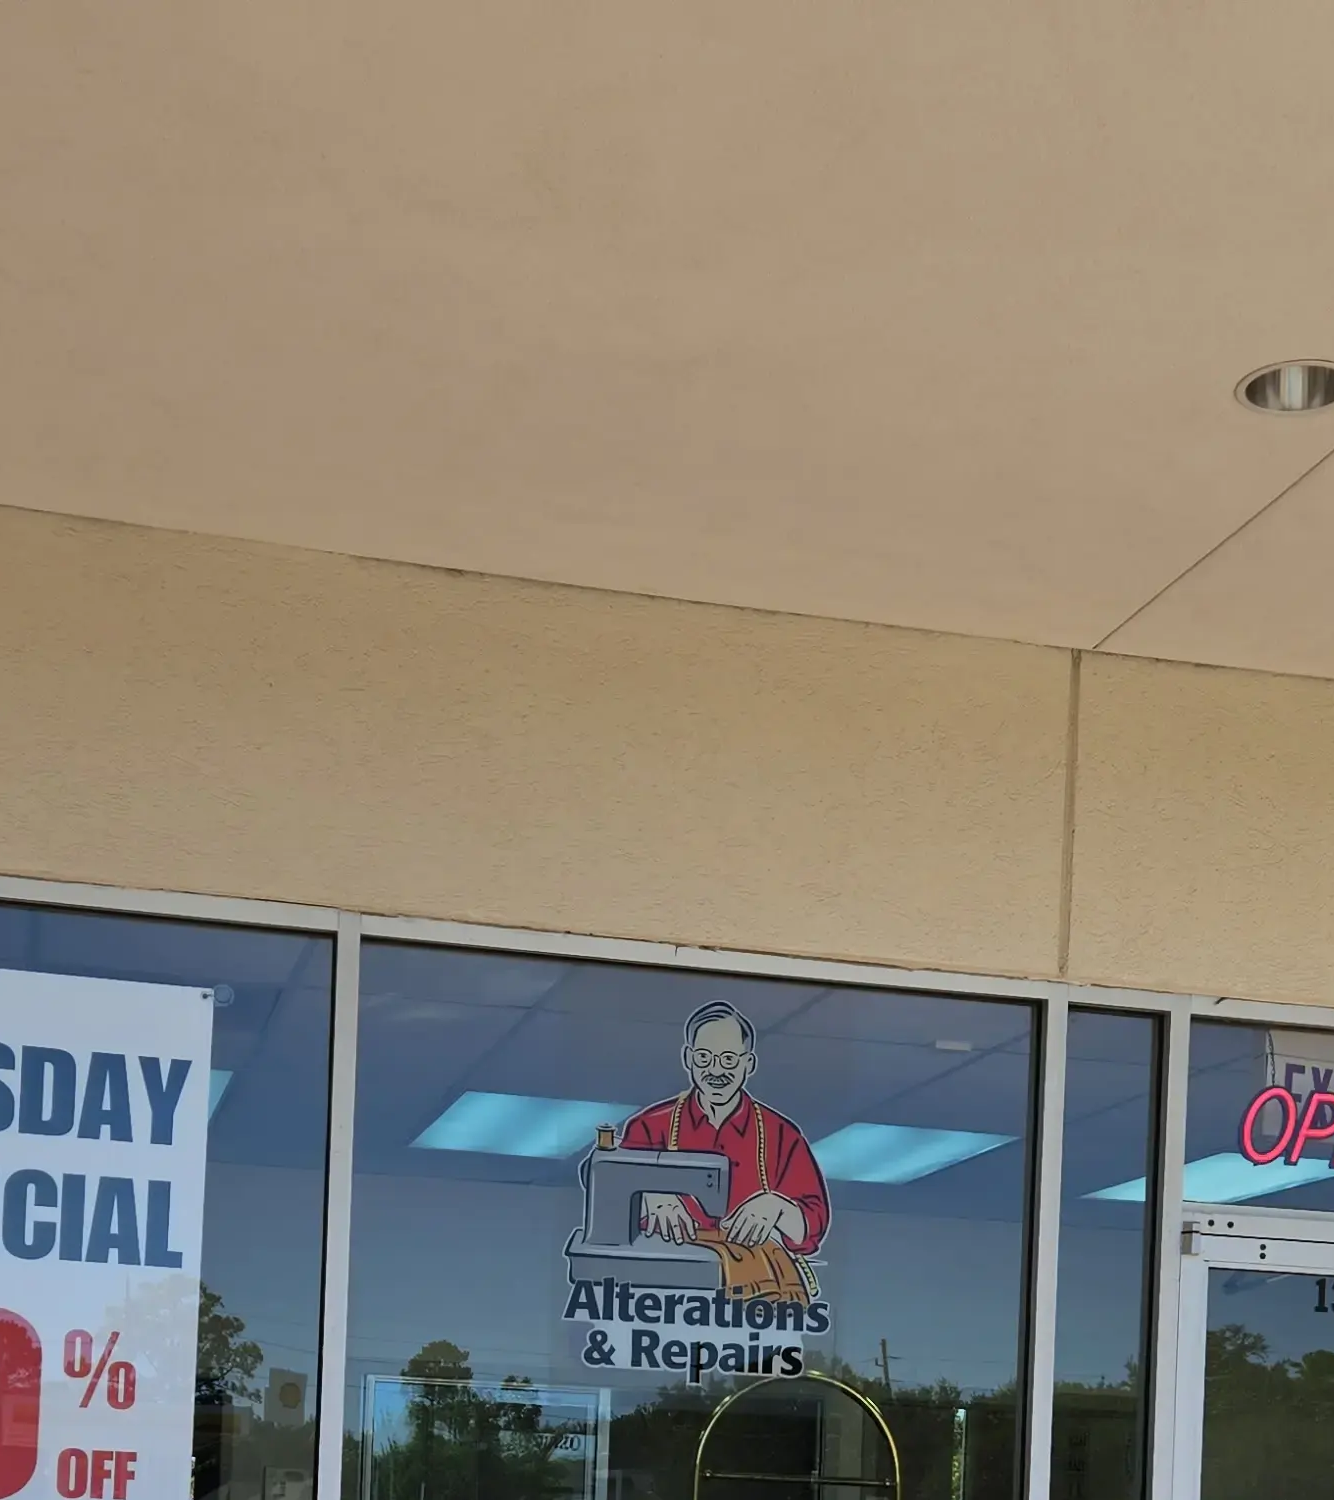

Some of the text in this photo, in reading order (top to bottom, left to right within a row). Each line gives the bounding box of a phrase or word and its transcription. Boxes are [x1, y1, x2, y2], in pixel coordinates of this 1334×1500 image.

[564, 1277, 829, 1333] Alterations
[583, 1329, 803, 1384] & Repairs
[57, 1447, 136, 1500] OFF
